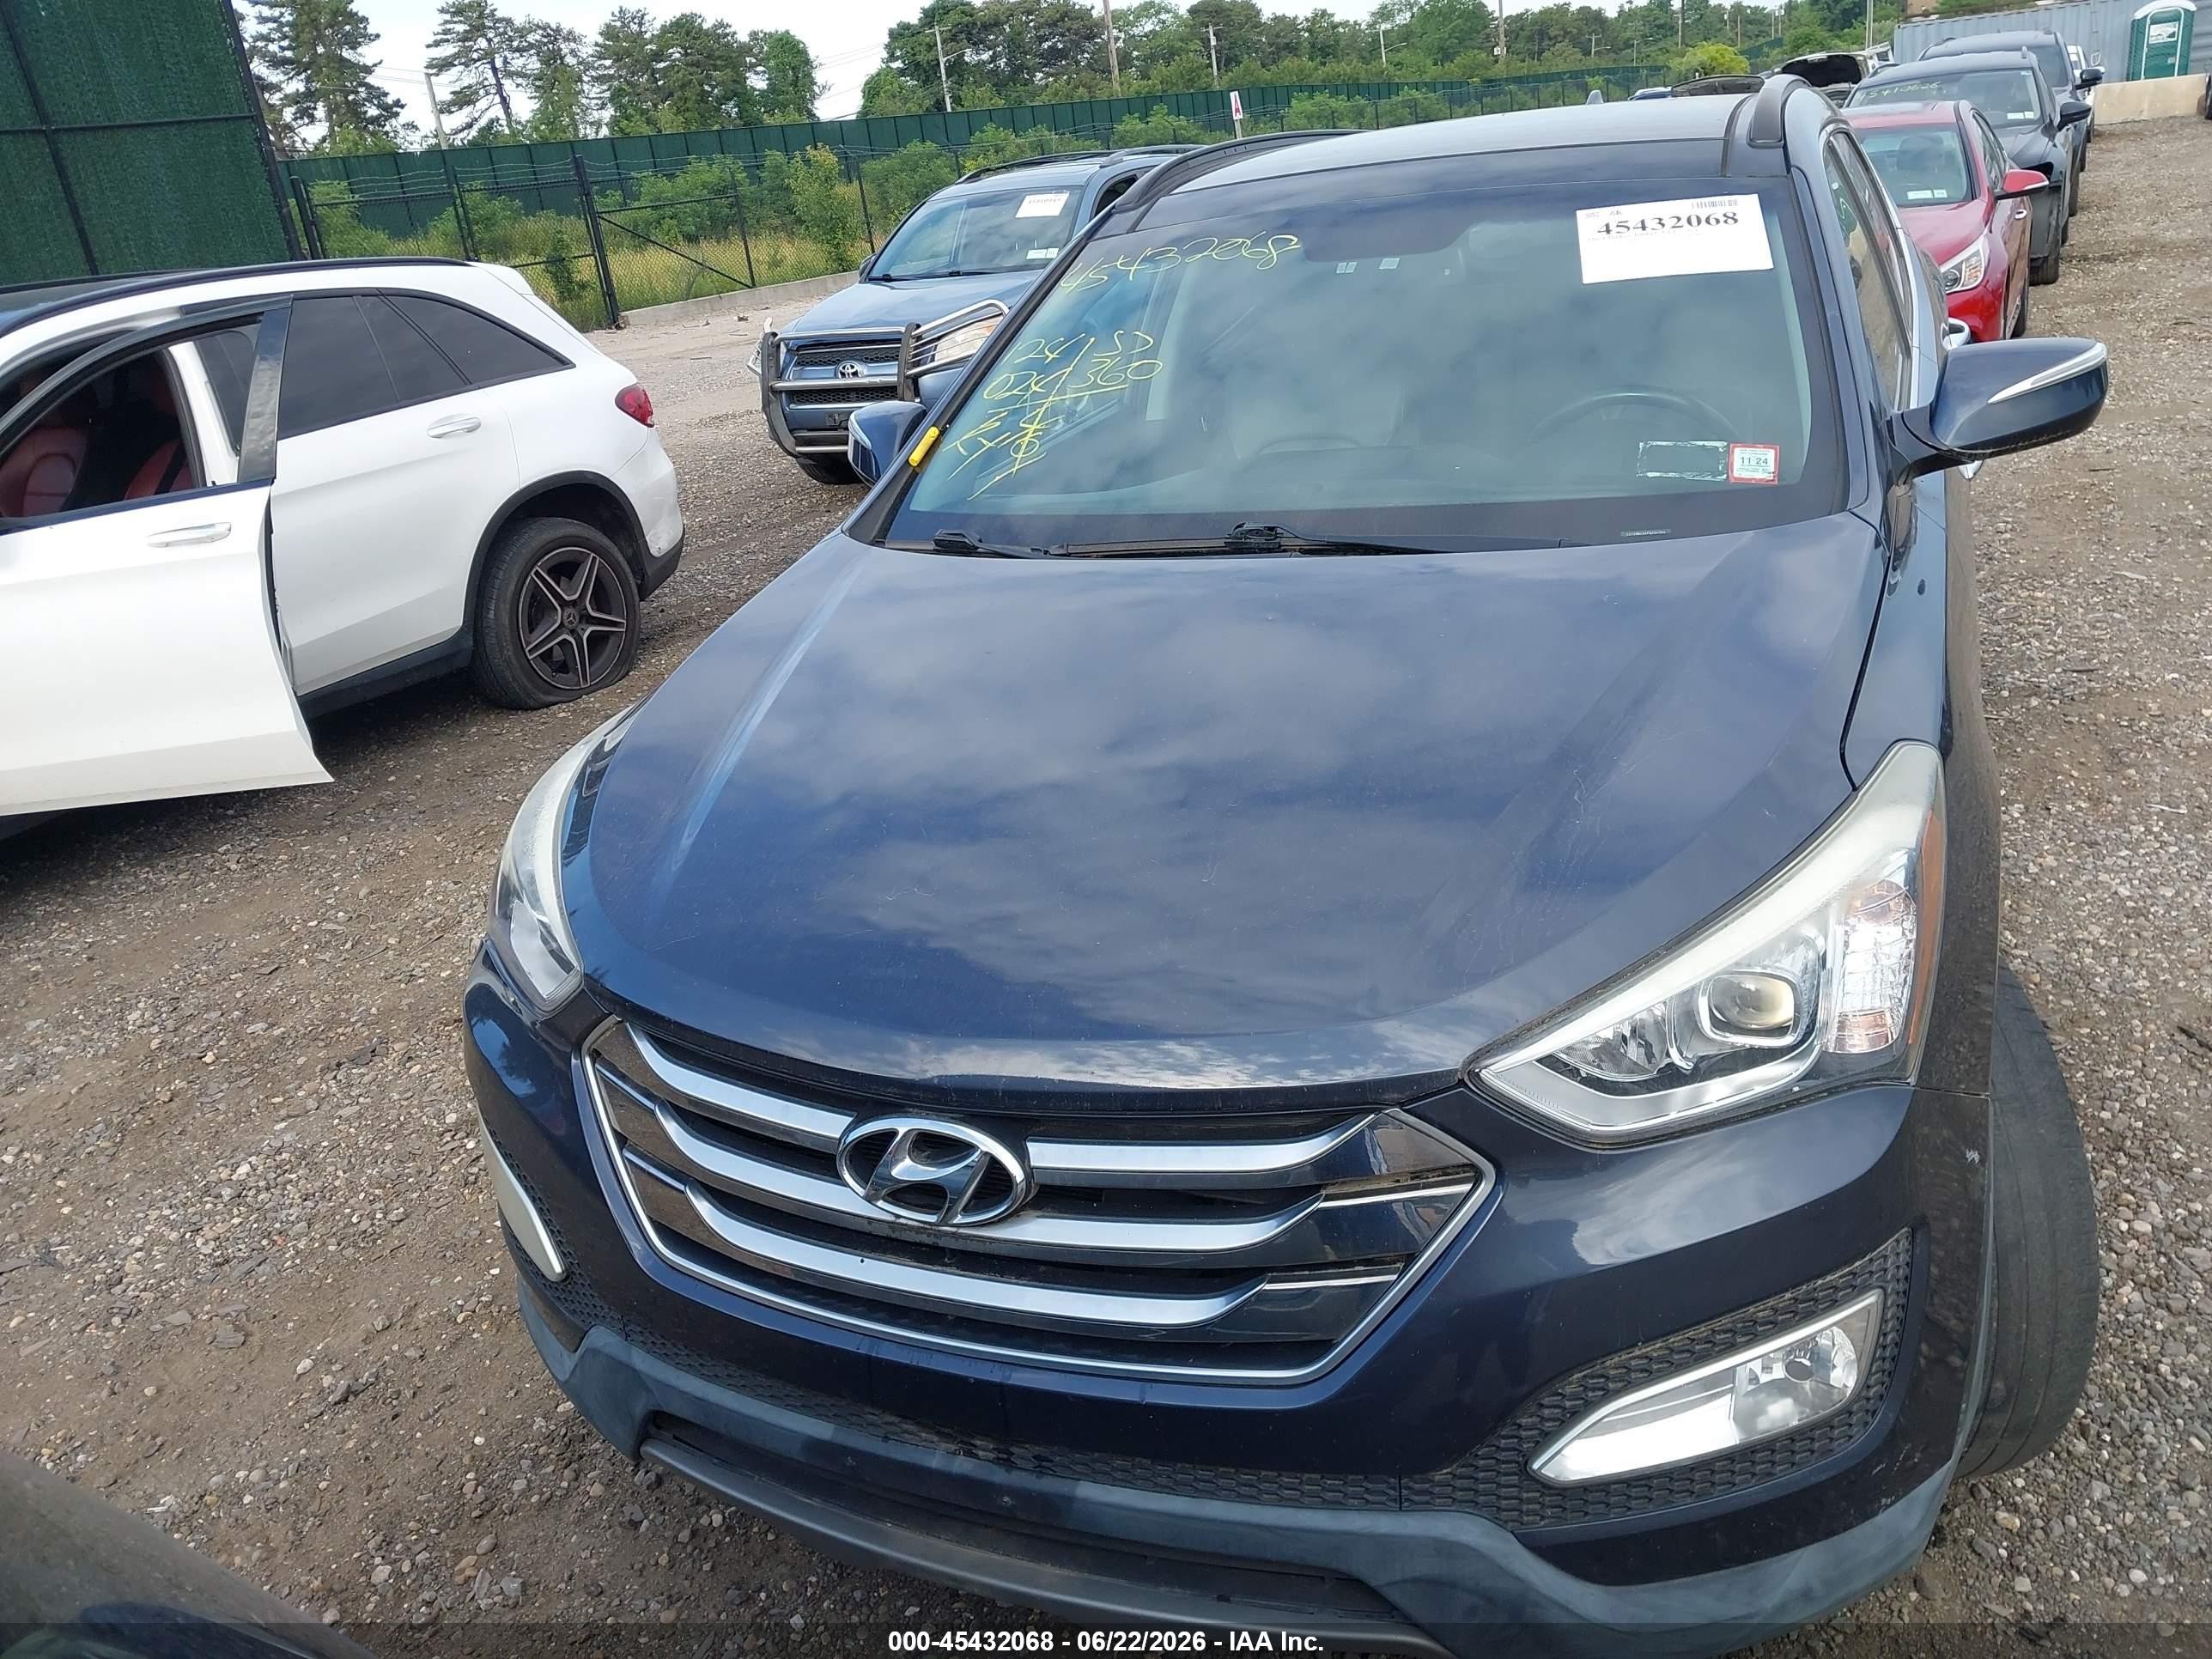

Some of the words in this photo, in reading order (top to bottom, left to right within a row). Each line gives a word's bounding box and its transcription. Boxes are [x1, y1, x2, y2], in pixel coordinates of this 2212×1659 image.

[1234, 93, 1242, 117] A
[1597, 211, 1739, 235] 45432068
[1060, 231, 1302, 294] 45432068
